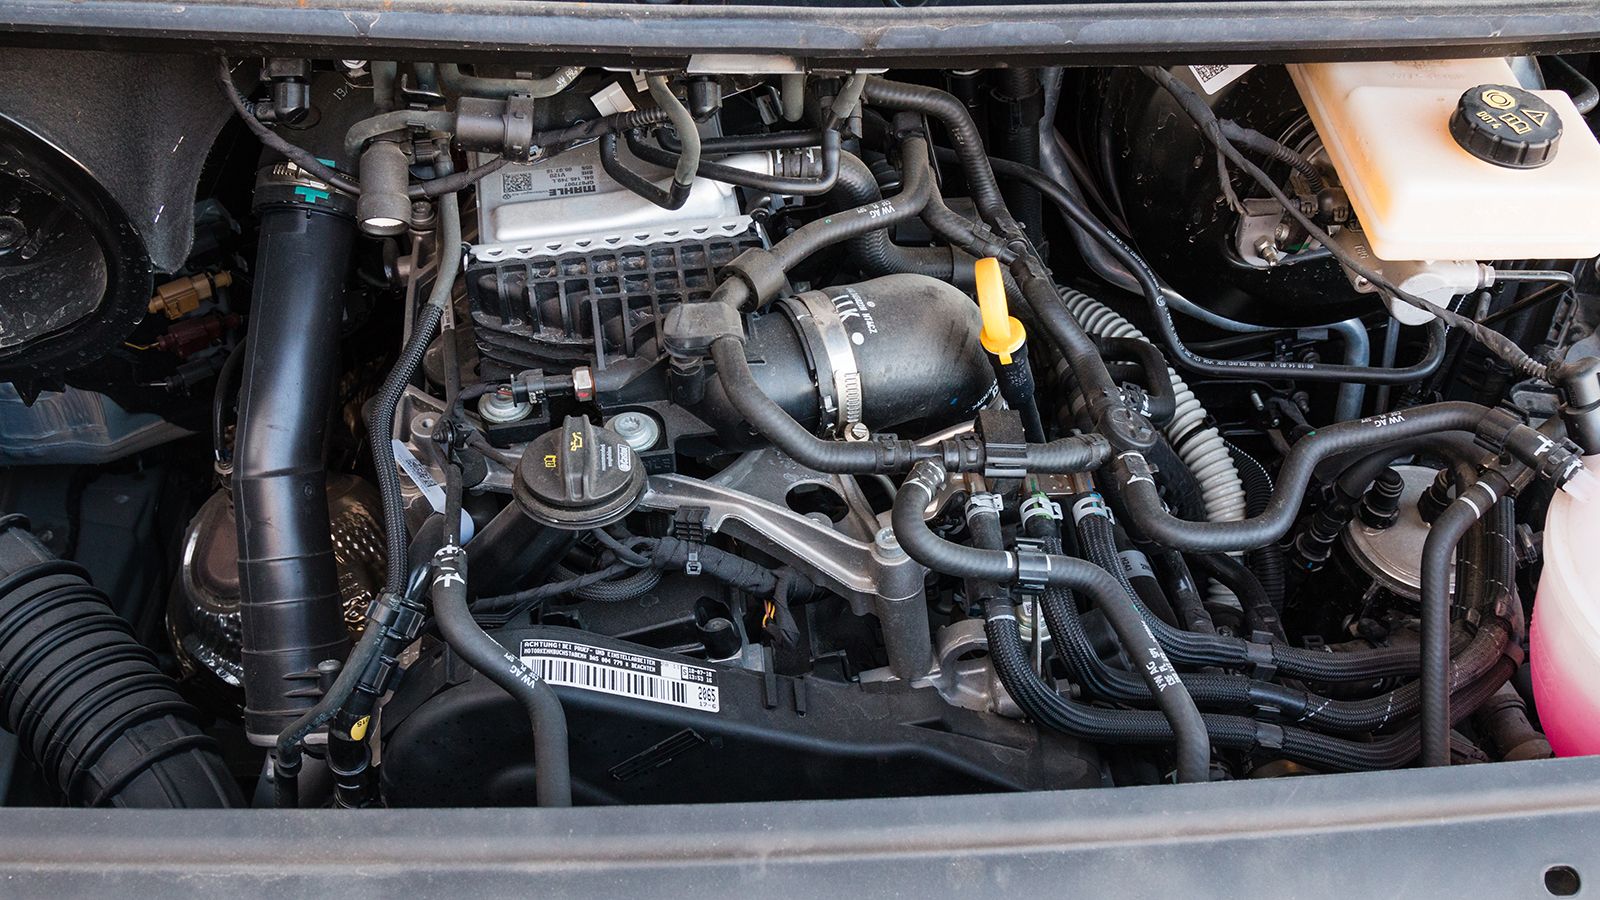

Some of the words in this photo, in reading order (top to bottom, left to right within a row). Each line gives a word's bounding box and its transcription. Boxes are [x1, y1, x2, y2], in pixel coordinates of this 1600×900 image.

[1476, 110, 1497, 123] DOT
[549, 185, 596, 196] MAHLE
[869, 209, 880, 219] AG
[881, 205, 896, 215] VW
[1374, 419, 1387, 428] AG
[1388, 415, 1406, 425] VW
[524, 641, 561, 649] ACHTUNG!
[595, 649, 605, 657] UND
[607, 651, 656, 666] EINSTELLARBEITEN
[509, 664, 523, 677] AG
[1145, 661, 1159, 675] AG
[520, 674, 535, 689] VW
[1153, 674, 1167, 692] VW
[698, 686, 716, 702] 2065
